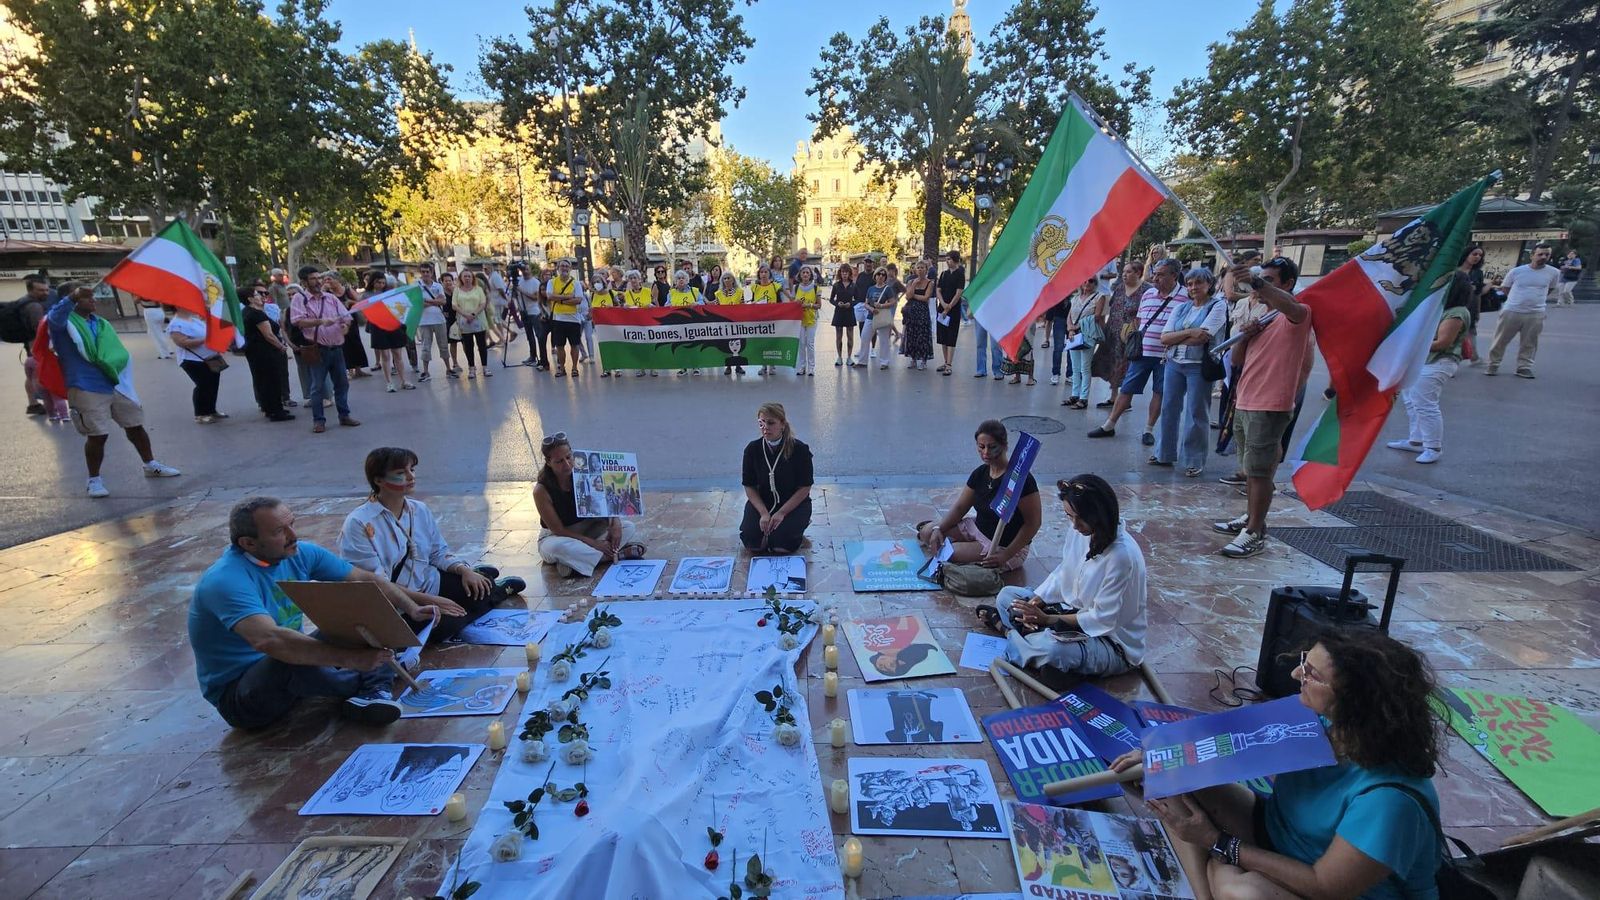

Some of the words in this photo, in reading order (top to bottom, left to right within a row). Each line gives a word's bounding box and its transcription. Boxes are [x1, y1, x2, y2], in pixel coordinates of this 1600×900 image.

[623, 328, 646, 340] Iran:
[647, 328, 682, 340] Dones,
[684, 326, 722, 340] Igualtat
[725, 325, 729, 337] i
[731, 323, 776, 336] Llibertat!
[990, 711, 1073, 738] LIBERTAD
[1087, 712, 1117, 730] VIDA
[997, 727, 1096, 770] VIDA
[1195, 736, 1218, 763] VIDA
[1013, 758, 1105, 798] MUJER
[1029, 883, 1120, 900] BERTAD
